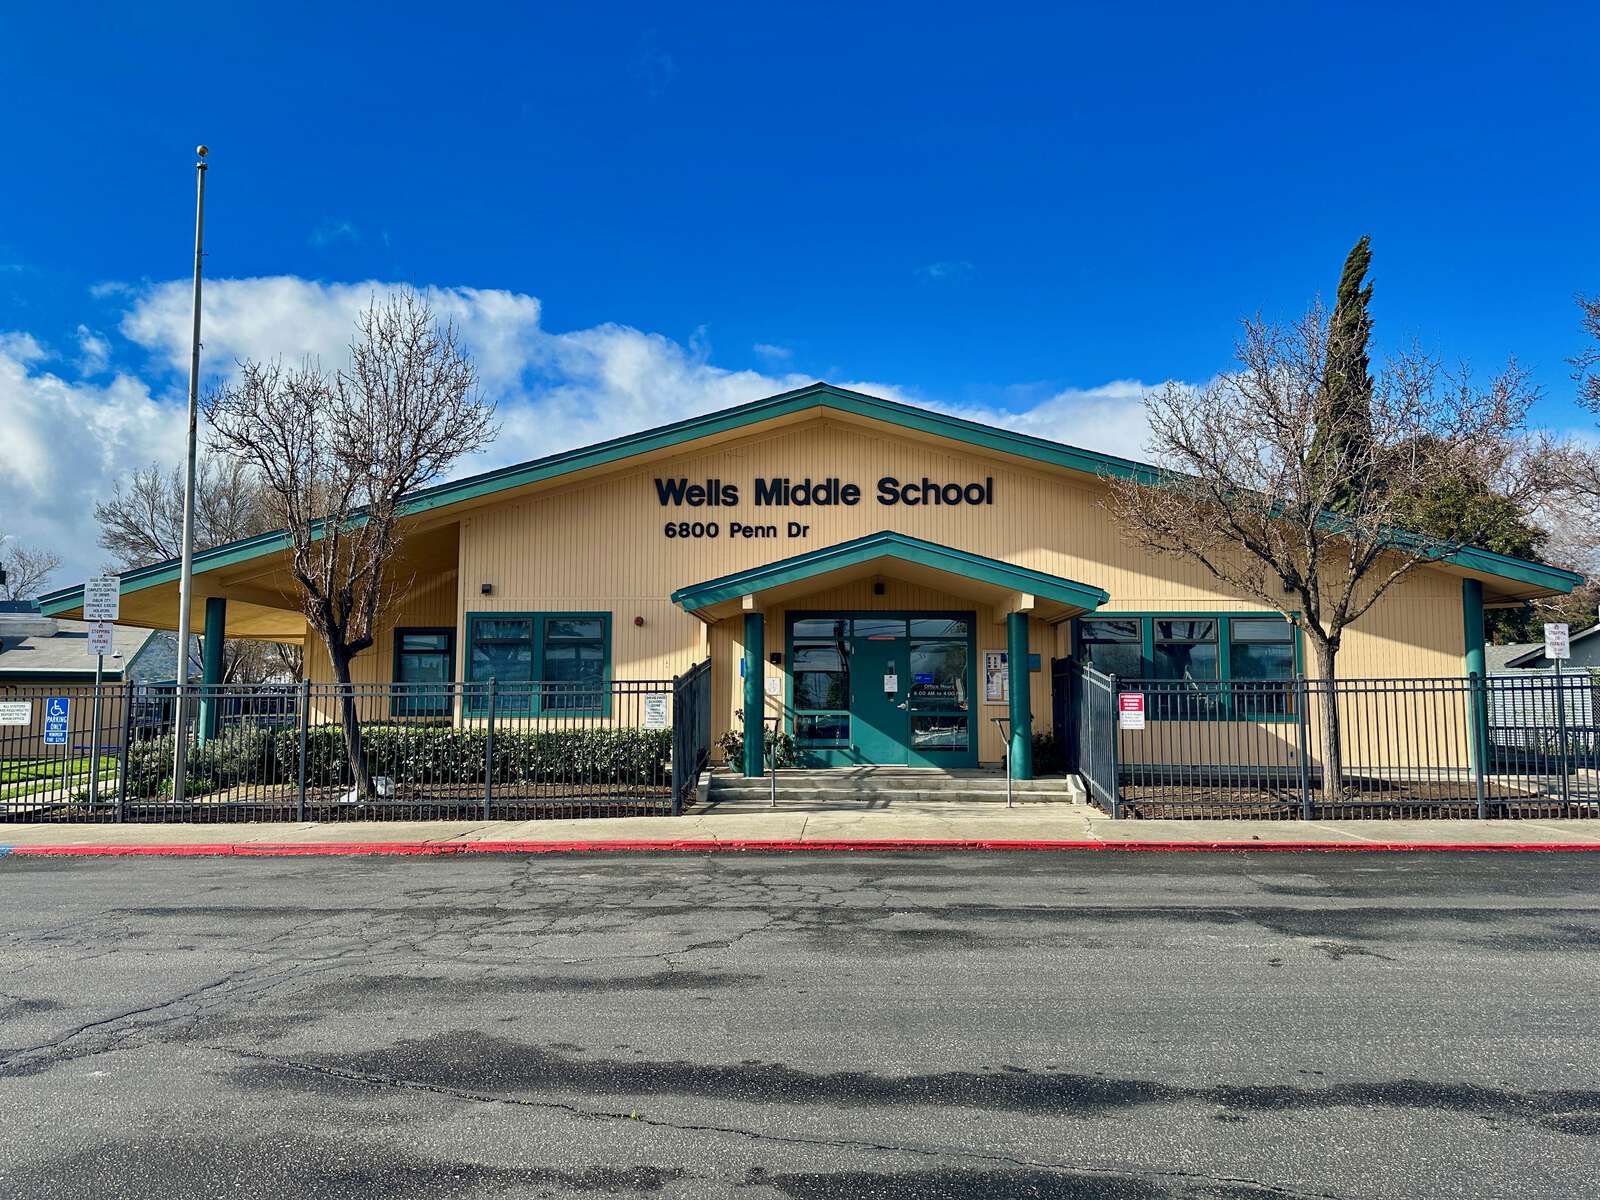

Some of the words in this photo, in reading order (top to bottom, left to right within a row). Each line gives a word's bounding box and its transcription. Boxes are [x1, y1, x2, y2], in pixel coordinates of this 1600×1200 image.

[655, 478, 739, 506] Wells
[754, 478, 861, 506] Middle
[877, 477, 993, 506] School
[664, 522, 719, 539] 6800
[729, 522, 777, 538] Penn
[787, 522, 810, 538] Dr
